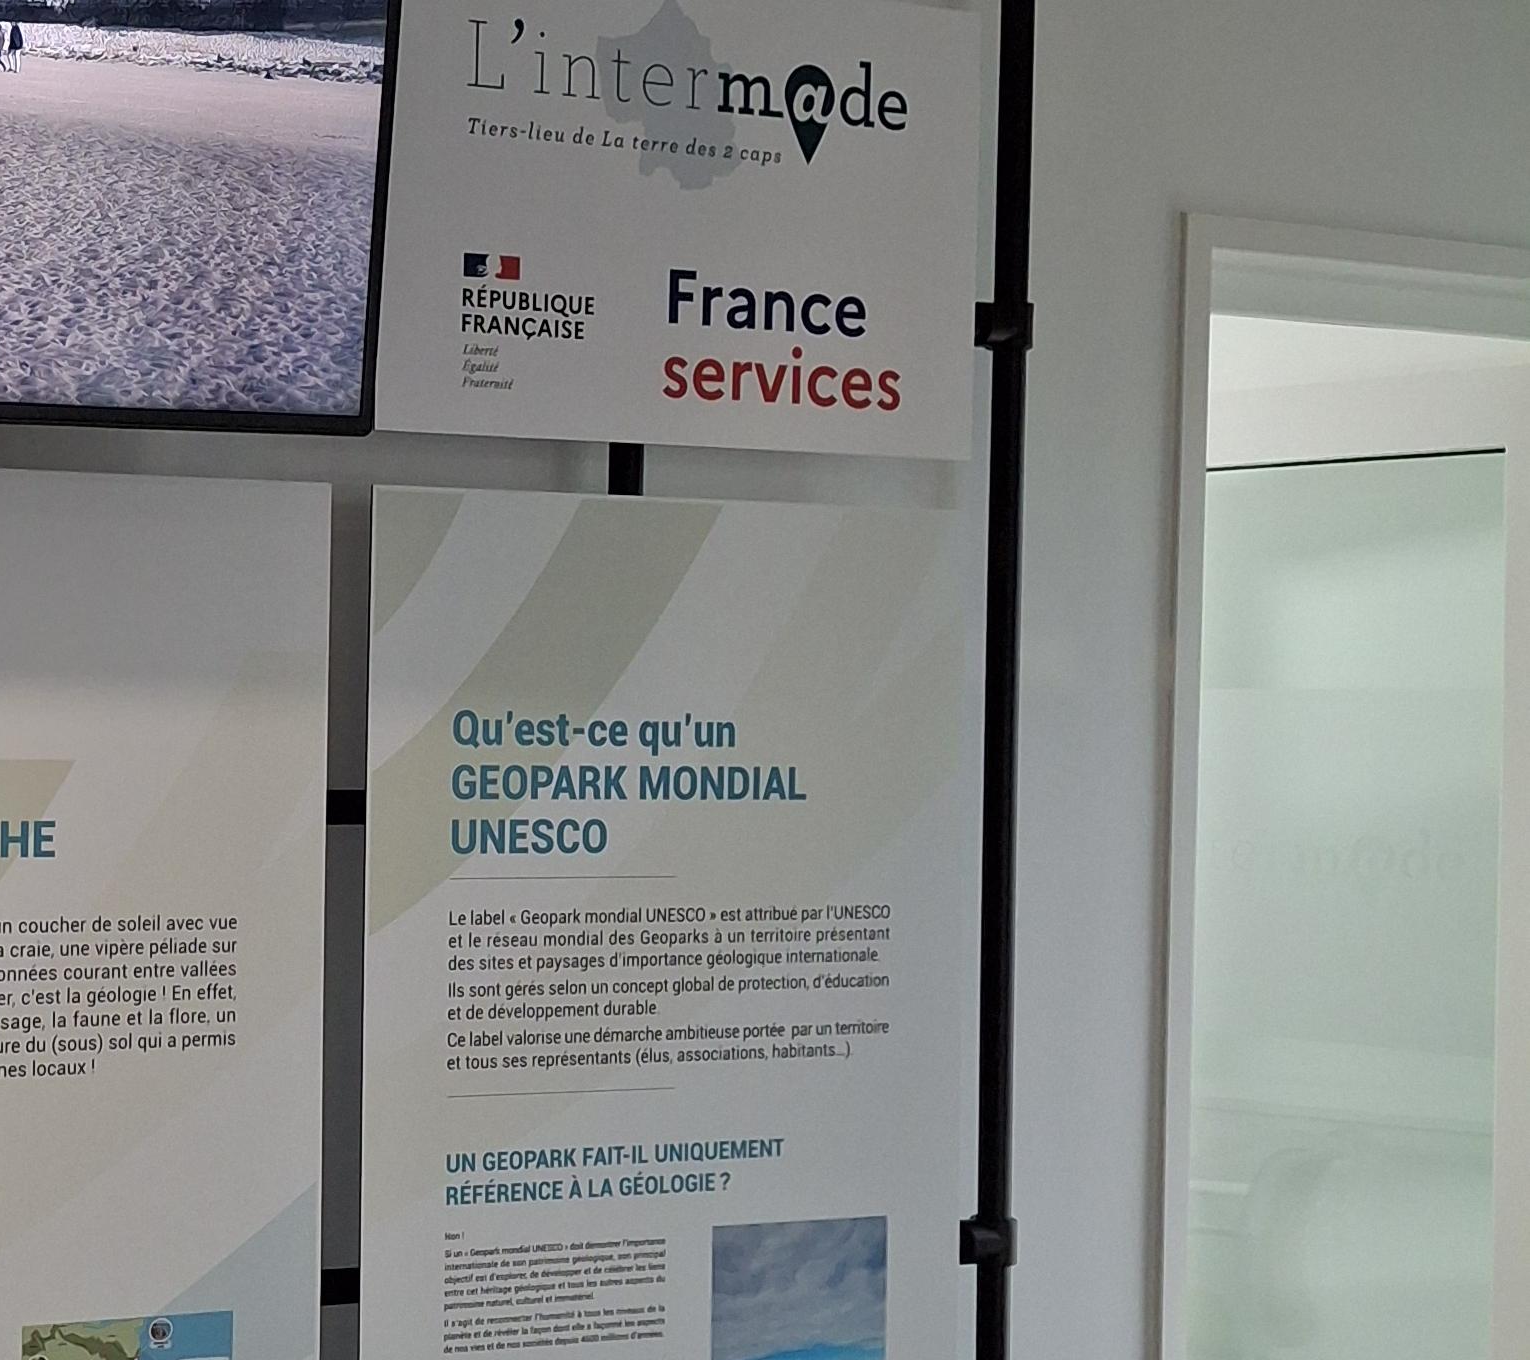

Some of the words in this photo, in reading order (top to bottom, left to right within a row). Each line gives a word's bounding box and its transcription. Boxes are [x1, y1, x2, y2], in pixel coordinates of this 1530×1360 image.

[468, 117, 565, 143] Tiers-lieu
[572, 125, 595, 146] de
[601, 130, 624, 149] La
[632, 136, 679, 154] terre
[685, 137, 717, 158] des
[722, 145, 734, 159] 2
[740, 148, 782, 167] caps
[462, 284, 596, 316] RÉPUBLIQUE
[667, 269, 868, 337] France
[461, 313, 586, 341] FRANÇAISE
[662, 347, 902, 411] services
[453, 709, 629, 749] Qu'est-ce
[638, 712, 736, 757] qu'un
[452, 764, 628, 801] GEOPARK
[639, 765, 807, 801] MONDIAL
[451, 818, 608, 855] UNESCO
[18, 915, 87, 934] coucher
[91, 915, 112, 933] de
[117, 914, 161, 932] soleil
[166, 918, 204, 931] avec
[209, 917, 238, 930] vue
[448, 934, 463, 949] et
[468, 931, 482, 948] le
[486, 935, 538, 948] réseau
[543, 929, 604, 947] mondial
[608, 929, 635, 946] des
[640, 928, 709, 948] Geoparks
[714, 927, 723, 944] à
[727, 931, 745, 944] un
[750, 928, 812, 943] territoire
[816, 927, 890, 944] présentant
[9, 944, 55, 959] craie,
[59, 943, 90, 957] une
[94, 938, 145, 960] vipère
[149, 936, 207, 959] péliade
[212, 940, 237, 954] sur
[448, 954, 475, 971] des
[478, 955, 514, 971] sites
[518, 954, 533, 970] et
[536, 955, 606, 973] paysages
[609, 951, 703, 971] d'importance
[63, 964, 128, 981] courant
[133, 963, 175, 979] entre
[180, 959, 237, 978] vallées
[448, 981, 465, 998] Ils
[468, 982, 502, 998] sont
[548, 978, 587, 996] selon
[591, 982, 609, 995] un
[612, 978, 669, 996] concept
[672, 975, 715, 997] global
[718, 975, 735, 992] de
[738, 976, 810, 995] protection,
[25, 1035, 46, 1053] du
[51, 1033, 103, 1057] (sous)
[108, 1032, 132, 1050] sol
[137, 1031, 162, 1053] qui
[167, 1035, 177, 1048] a
[181, 1033, 236, 1052] permis
[32, 1059, 86, 1077] locaux
[446, 1152, 476, 1174] UN
[482, 1147, 577, 1172] GEOPARK
[582, 1144, 649, 1167] FAIT-IL
[655, 1138, 785, 1163] UNIQUEMENT
[445, 1178, 564, 1206] RÉFÉRENCE
[568, 1174, 583, 1199] À
[588, 1177, 613, 1198] LA
[618, 1170, 716, 1197] GÉOLOGIE
